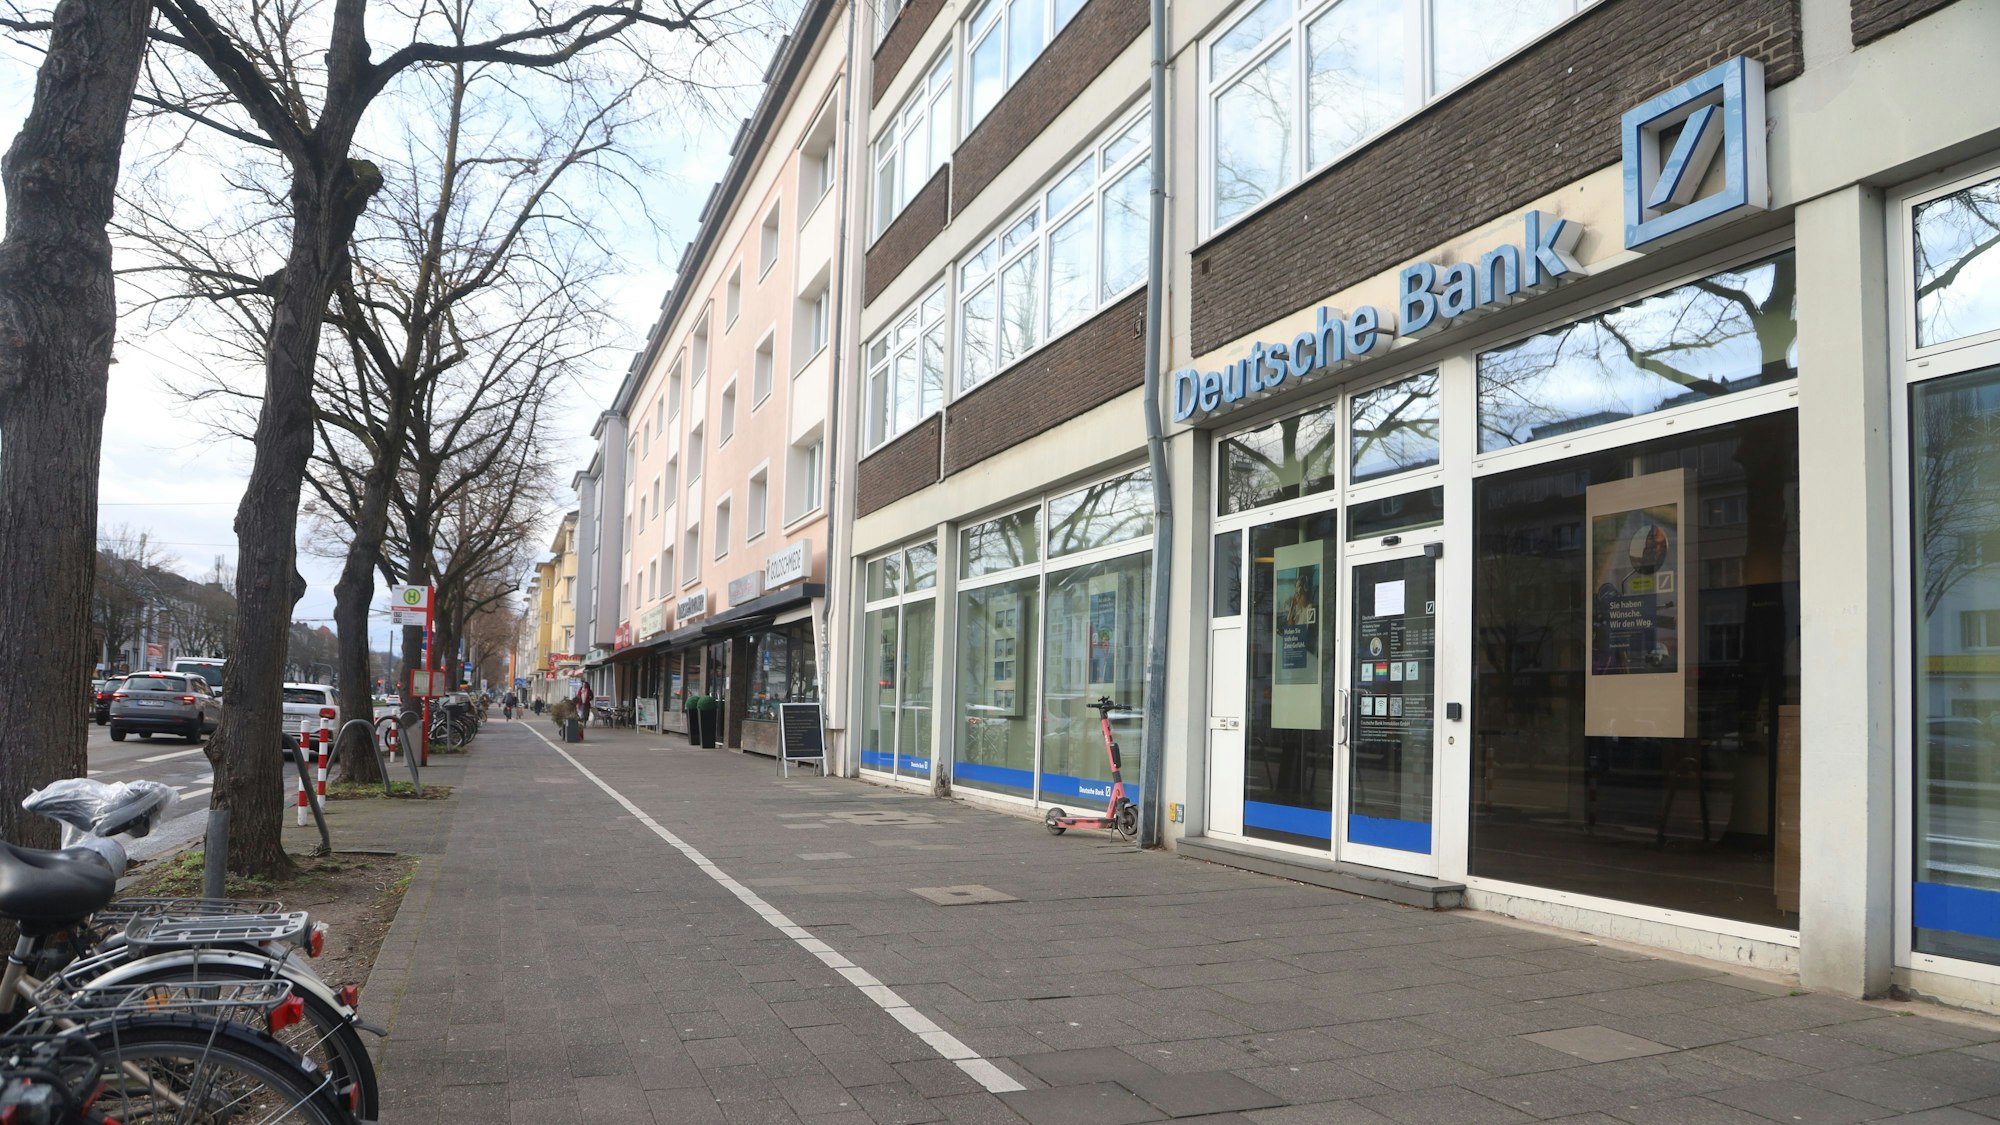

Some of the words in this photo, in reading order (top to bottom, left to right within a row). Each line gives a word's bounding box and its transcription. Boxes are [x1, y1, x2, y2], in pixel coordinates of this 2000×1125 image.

[1174, 306, 1381, 424] Deutsche
[1399, 210, 1579, 337] Bank
[770, 549, 801, 580] GOLDSCHMIEDE
[1609, 601, 1620, 610] Sie
[1621, 600, 1642, 608] haben
[1609, 609, 1642, 619] Wünsche.
[1609, 620, 1621, 629] Wir
[1622, 620, 1635, 628] den
[1636, 619, 1653, 628] Weg.
[1079, 785, 1094, 795] Deutsche
[1095, 788, 1105, 796] Bank
